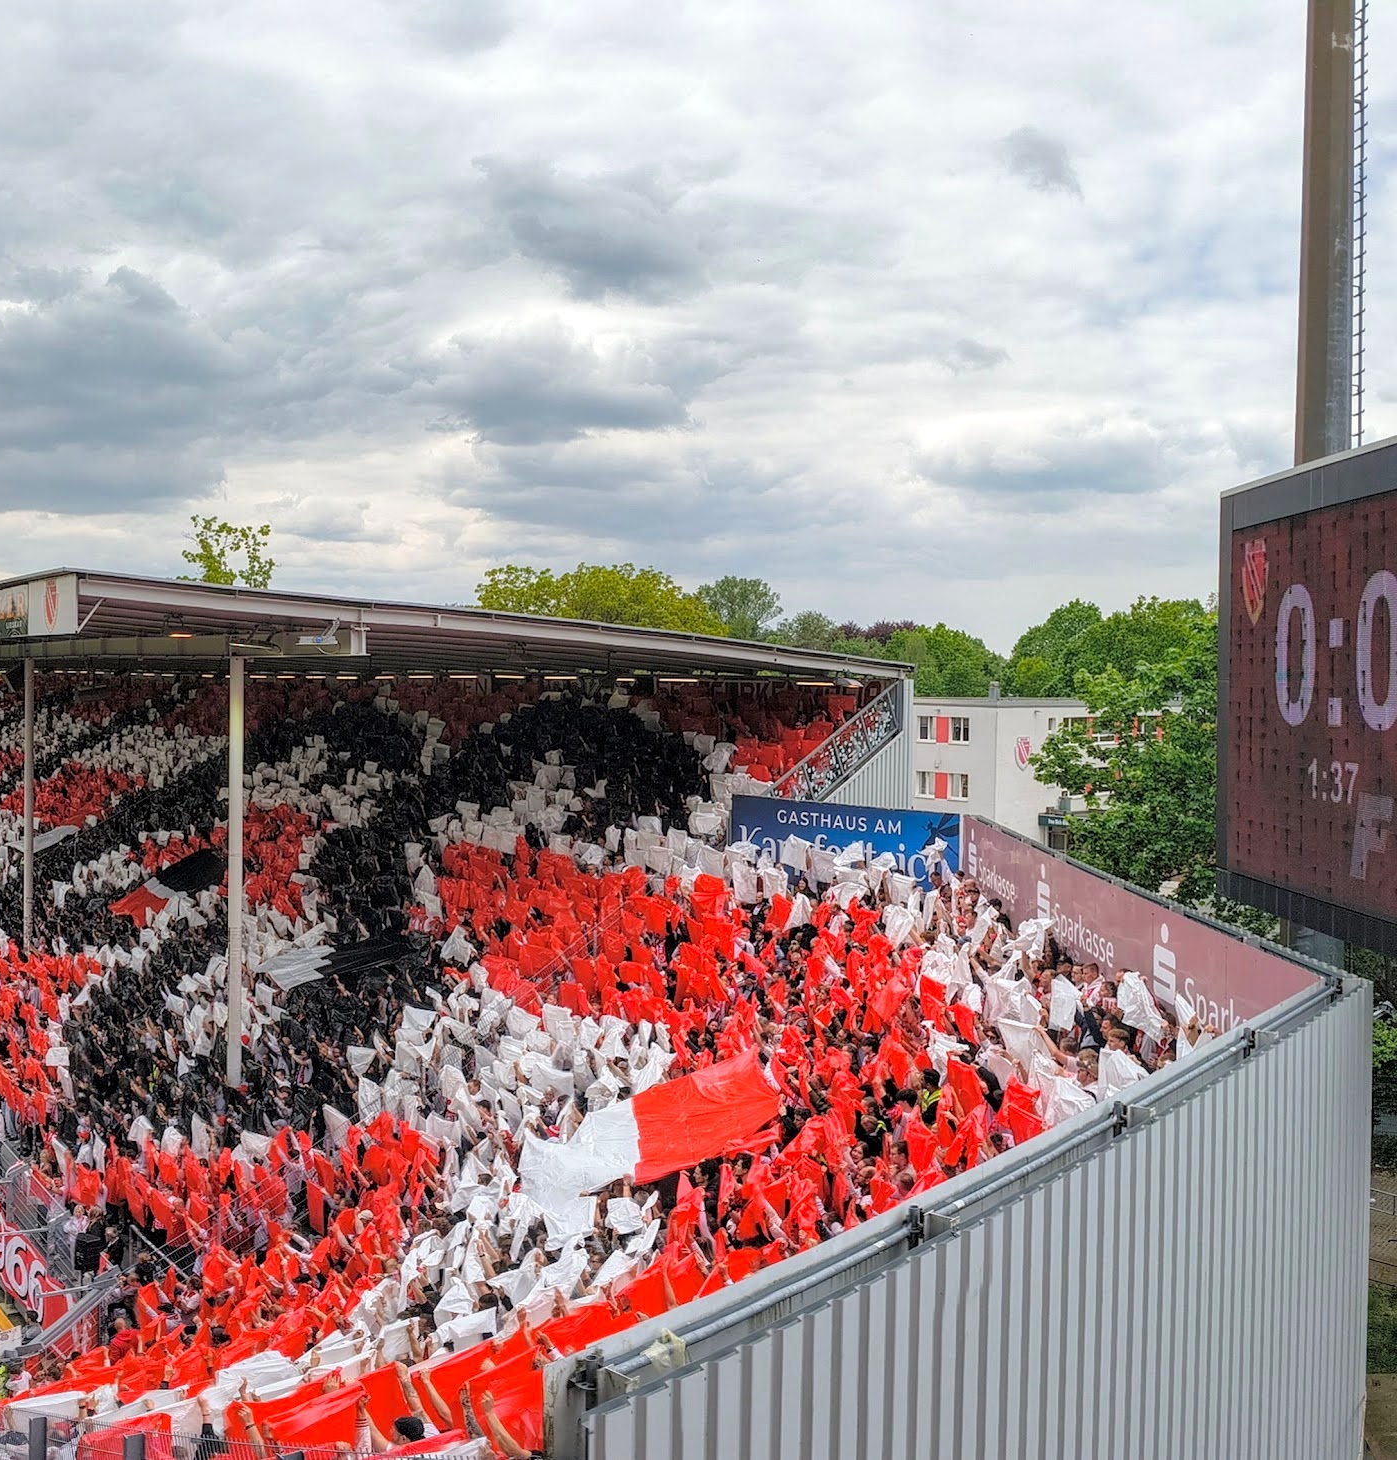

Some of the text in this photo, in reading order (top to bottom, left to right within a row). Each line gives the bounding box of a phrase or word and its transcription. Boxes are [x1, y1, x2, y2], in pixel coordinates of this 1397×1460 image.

[1307, 757, 1359, 804] 1:37
[776, 809, 903, 836] GASTHAUS AM
[978, 857, 1016, 903] Sparkasse
[1055, 903, 1114, 968] Sparkasse
